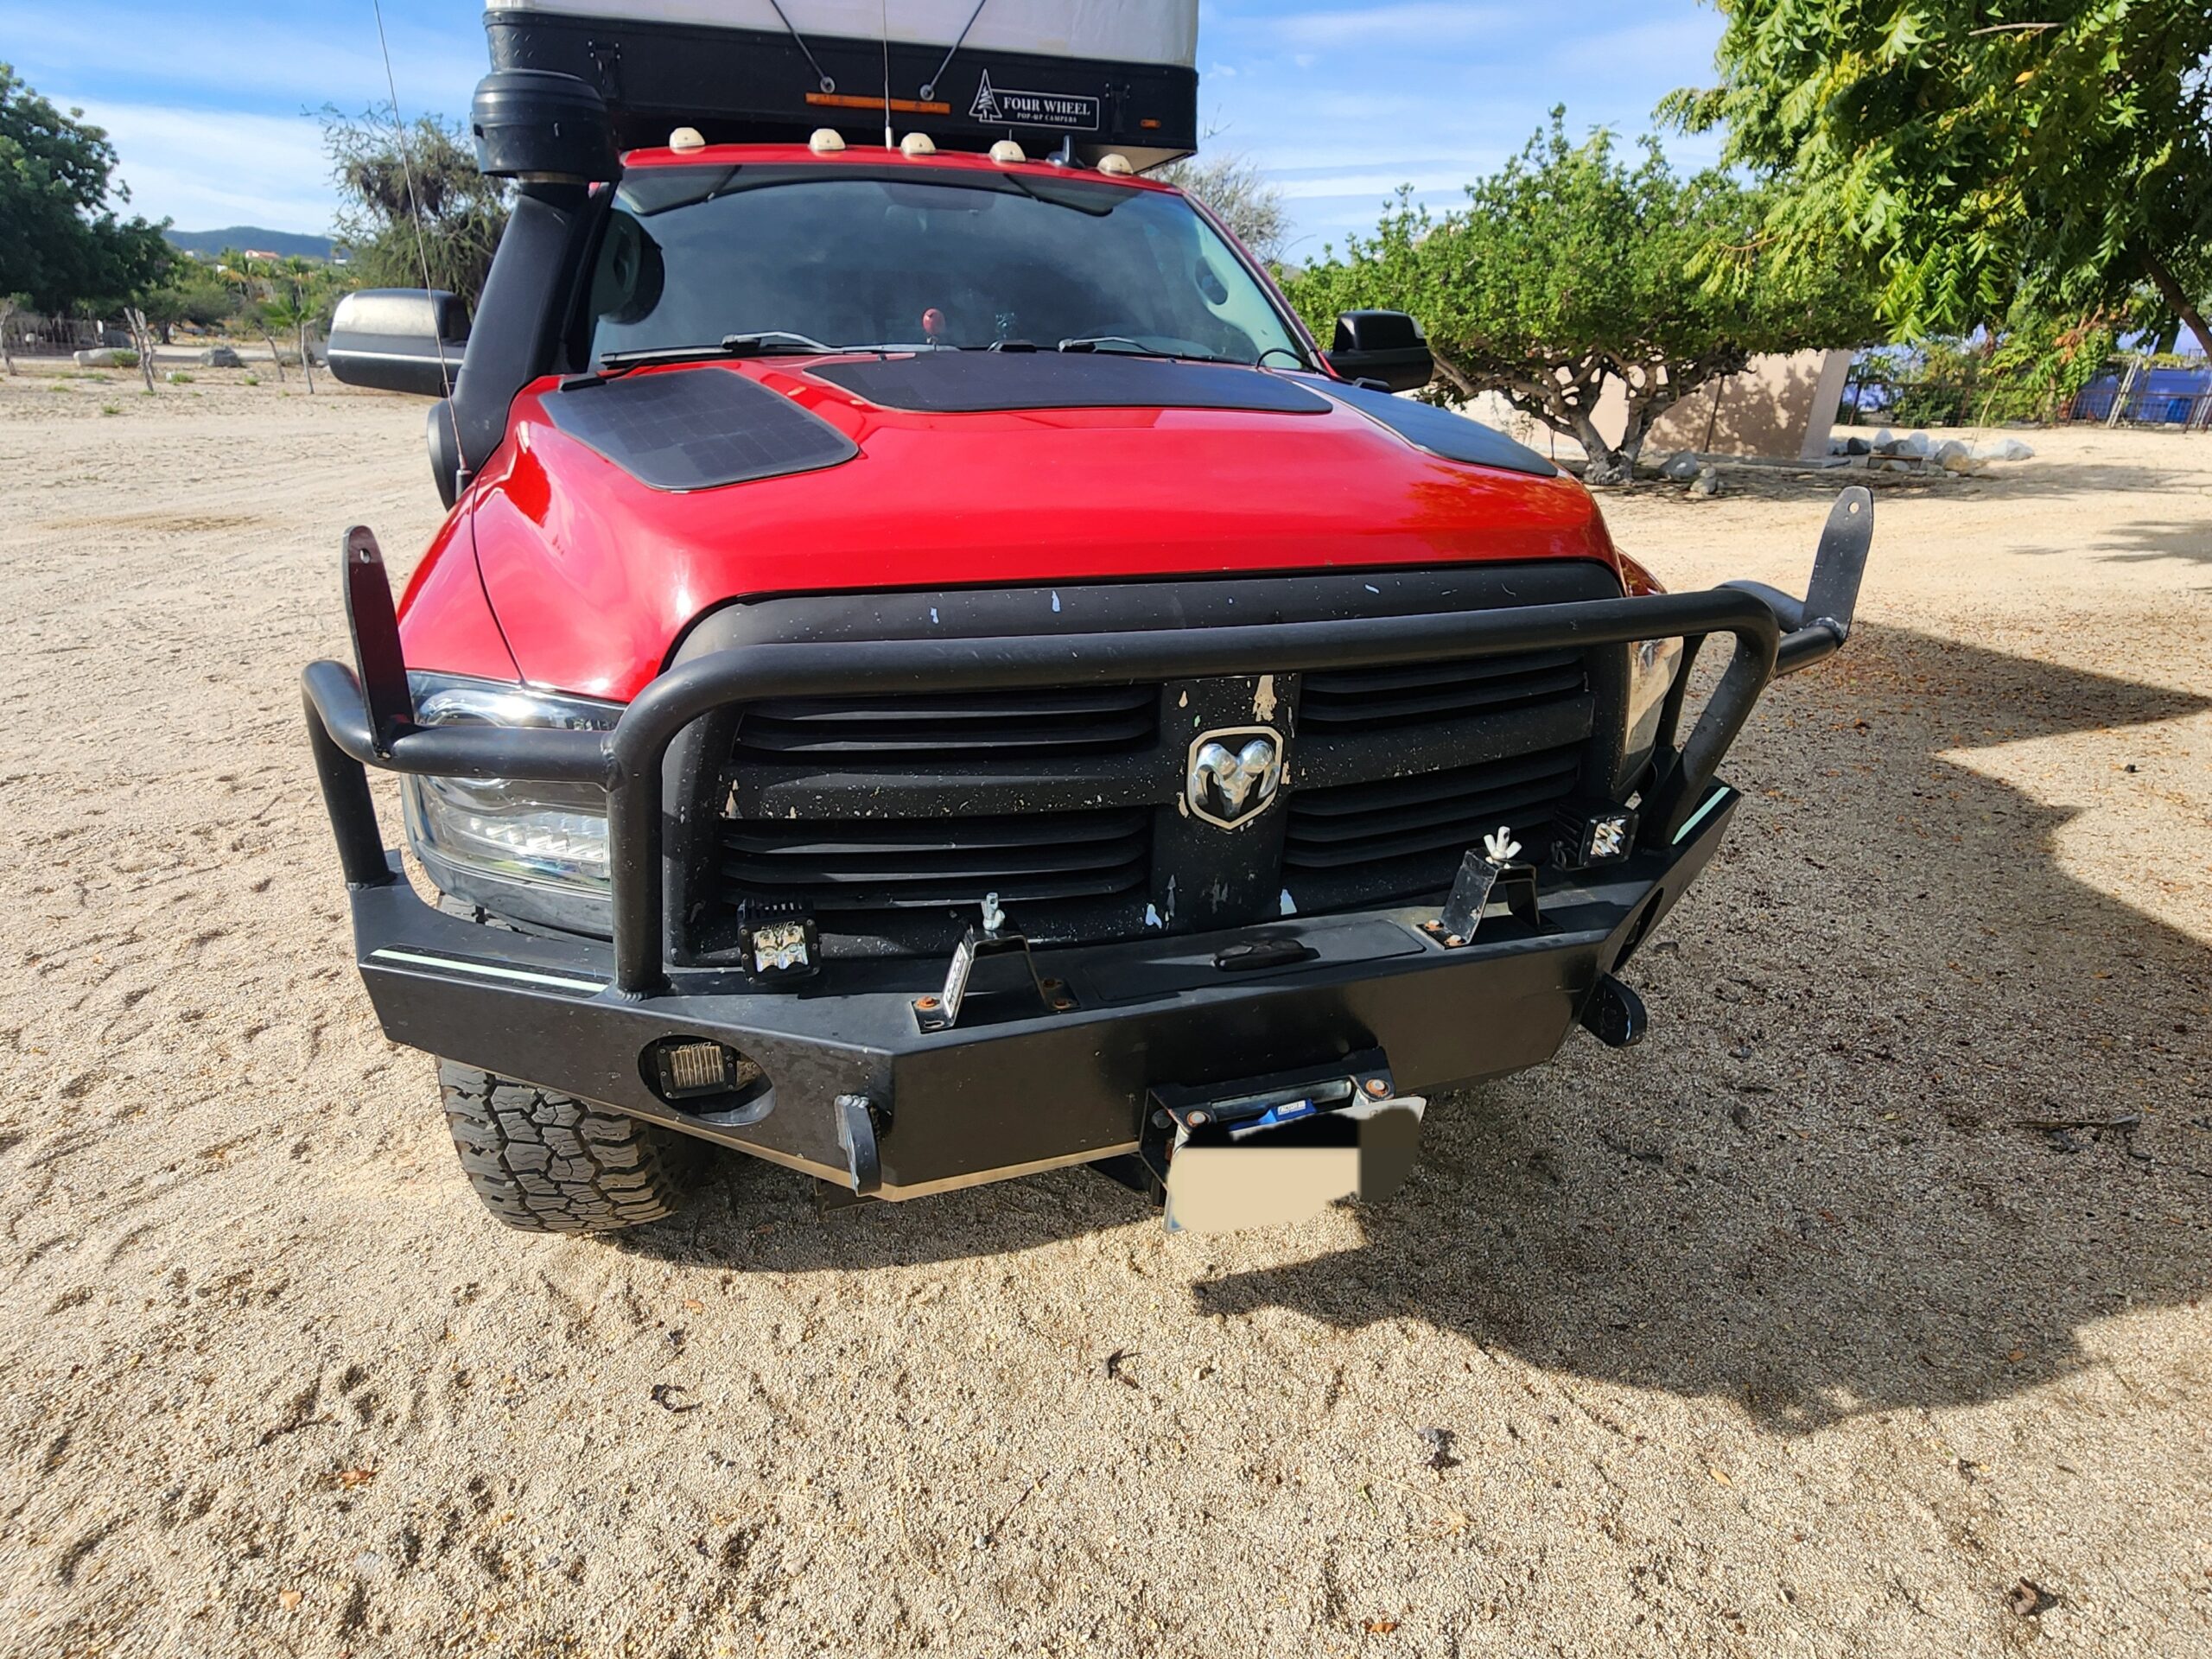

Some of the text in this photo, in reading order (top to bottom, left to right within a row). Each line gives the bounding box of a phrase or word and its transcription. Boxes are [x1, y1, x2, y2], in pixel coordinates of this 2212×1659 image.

[1003, 97, 1090, 116] FOUR WHEEL
[1017, 112, 1077, 124] POP-UP CAMPERS
[677, 1041, 712, 1052] RIGID
